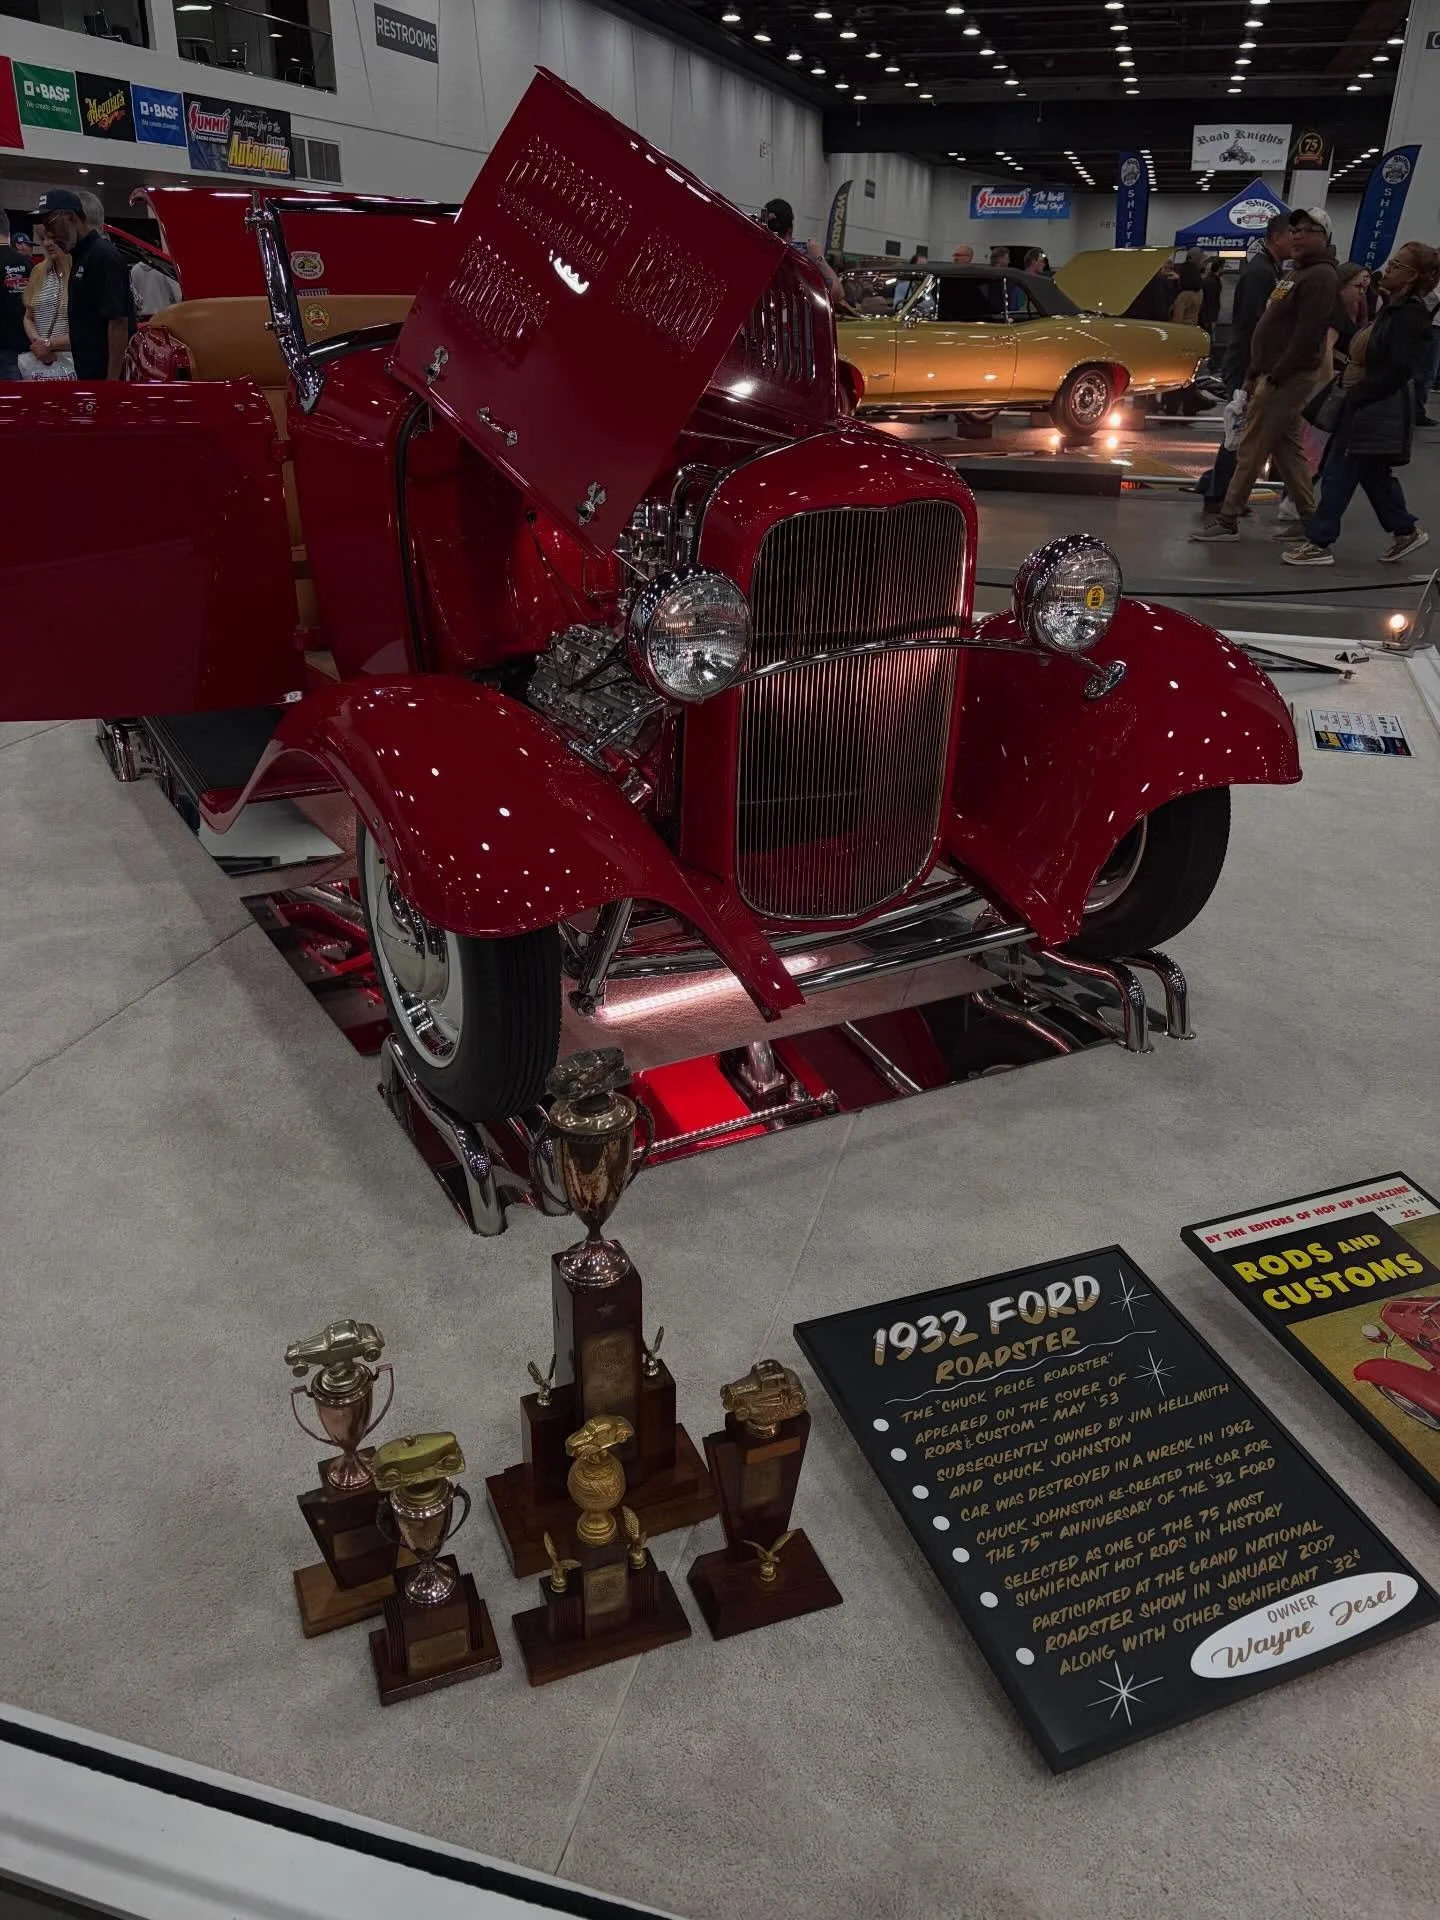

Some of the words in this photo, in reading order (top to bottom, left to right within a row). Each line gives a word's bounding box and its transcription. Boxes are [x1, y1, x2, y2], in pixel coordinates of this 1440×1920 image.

[376, 15, 437, 52] RESTROOMS
[26, 100, 34, 109] We
[39, 82, 71, 102] BASF
[154, 103, 179, 120] BASF
[188, 101, 232, 138] SUMMIT
[228, 131, 291, 174] Autorama
[1196, 130, 1230, 146] Road
[1234, 128, 1287, 145] Knights
[1304, 138, 1318, 151] 75
[976, 188, 1031, 212] SUMMIT
[1196, 236, 1244, 247] Shifters
[1204, 1234, 1221, 1244] BY
[1224, 1228, 1246, 1240] THE
[1250, 1215, 1294, 1233] EDITORS
[1296, 1210, 1312, 1220] OF
[1313, 1204, 1336, 1216] HOP
[1338, 1199, 1355, 1210] UP
[1356, 1185, 1412, 1205] MAGAZINE
[1232, 1242, 1334, 1284] RODS
[1336, 1234, 1381, 1254] AND
[1262, 1252, 1424, 1310] CUSTOMS
[873, 1310, 978, 1366] 1932
[987, 1275, 1100, 1334] FORD
[936, 1327, 1080, 1384] ROADSTER
[901, 1406, 934, 1424] THE
[935, 1391, 988, 1412] "CHUCK
[994, 1376, 1036, 1397] PRICE
[1044, 1352, 1114, 1383] ROADSTER"
[915, 1414, 988, 1445] APPEARED
[996, 1407, 1015, 1422] ON
[1020, 1397, 1050, 1414] THE
[1055, 1382, 1100, 1404] COVER
[1108, 1373, 1128, 1387] OF
[924, 1440, 963, 1460] RODS
[976, 1419, 1035, 1446] CUSTOM
[1053, 1402, 1086, 1422] MAY
[1094, 1392, 1120, 1408] '53
[936, 1438, 1048, 1482] SUBSEQUENTLY
[1055, 1422, 1102, 1446] OWNED
[1108, 1415, 1124, 1430] BY
[1128, 1406, 1152, 1424] JIM
[1158, 1384, 1230, 1414] HELLMUTH
[950, 1479, 984, 1500] AND
[994, 1460, 1044, 1486] CHUCK
[1051, 1432, 1132, 1467] JOHNSTON
[960, 1504, 990, 1522] CAR
[996, 1492, 1024, 1512] WAS
[1029, 1465, 1110, 1502] DESTROYED
[1115, 1458, 1129, 1472] IN
[1132, 1454, 1144, 1468] A
[1147, 1437, 1196, 1463] WRECK
[1199, 1432, 1214, 1446] IN
[1220, 1419, 1256, 1439] 1962
[976, 1518, 1028, 1546] CHUCK
[1032, 1494, 1104, 1527] JOHNSTON
[1108, 1468, 1182, 1502] RE-CREATED
[1186, 1457, 1214, 1476] THE
[1214, 1449, 1241, 1466] CAR
[1244, 1438, 1272, 1457] FOR
[986, 1544, 1016, 1564] THE
[1059, 1498, 1152, 1540] ANNIVERSARY
[1157, 1490, 1176, 1506] OF
[1178, 1480, 1208, 1498] THE
[1210, 1471, 1236, 1488] '32
[1239, 1457, 1276, 1480] FORD
[1004, 1555, 1080, 1590] SELECTED
[1086, 1547, 1102, 1563] AS
[1104, 1536, 1135, 1556] ONE
[1137, 1528, 1156, 1544] OF
[1161, 1515, 1194, 1536] THE
[1199, 1506, 1220, 1524] 75
[1226, 1491, 1264, 1515] MOST
[1015, 1562, 1110, 1608] SIGNIFICANT
[1114, 1552, 1144, 1573] HOT
[1150, 1536, 1187, 1560] RODS
[1195, 1528, 1210, 1545] IN
[1220, 1502, 1284, 1536] HISTORY
[1032, 1586, 1132, 1632] PARTICIPATED
[1136, 1578, 1151, 1596] AT
[1154, 1566, 1186, 1588] THE
[1190, 1547, 1238, 1575] GRAND
[1246, 1520, 1324, 1556] NATIONAL
[1045, 1608, 1135, 1654] ROADSTER
[1139, 1589, 1186, 1618] SHOW
[1193, 1580, 1210, 1600] IN
[1217, 1550, 1288, 1590] JANUARY
[1298, 1534, 1336, 1561] 2007
[1060, 1644, 1116, 1676] ALONG
[1122, 1624, 1166, 1653] WITH
[1173, 1603, 1224, 1633] OTHER
[1228, 1566, 1319, 1612] SIGNIFICANT
[1210, 1620, 1314, 1669] Wayne
[1329, 1580, 1396, 1626] Jesel
[1268, 1594, 1319, 1624] OWNER
